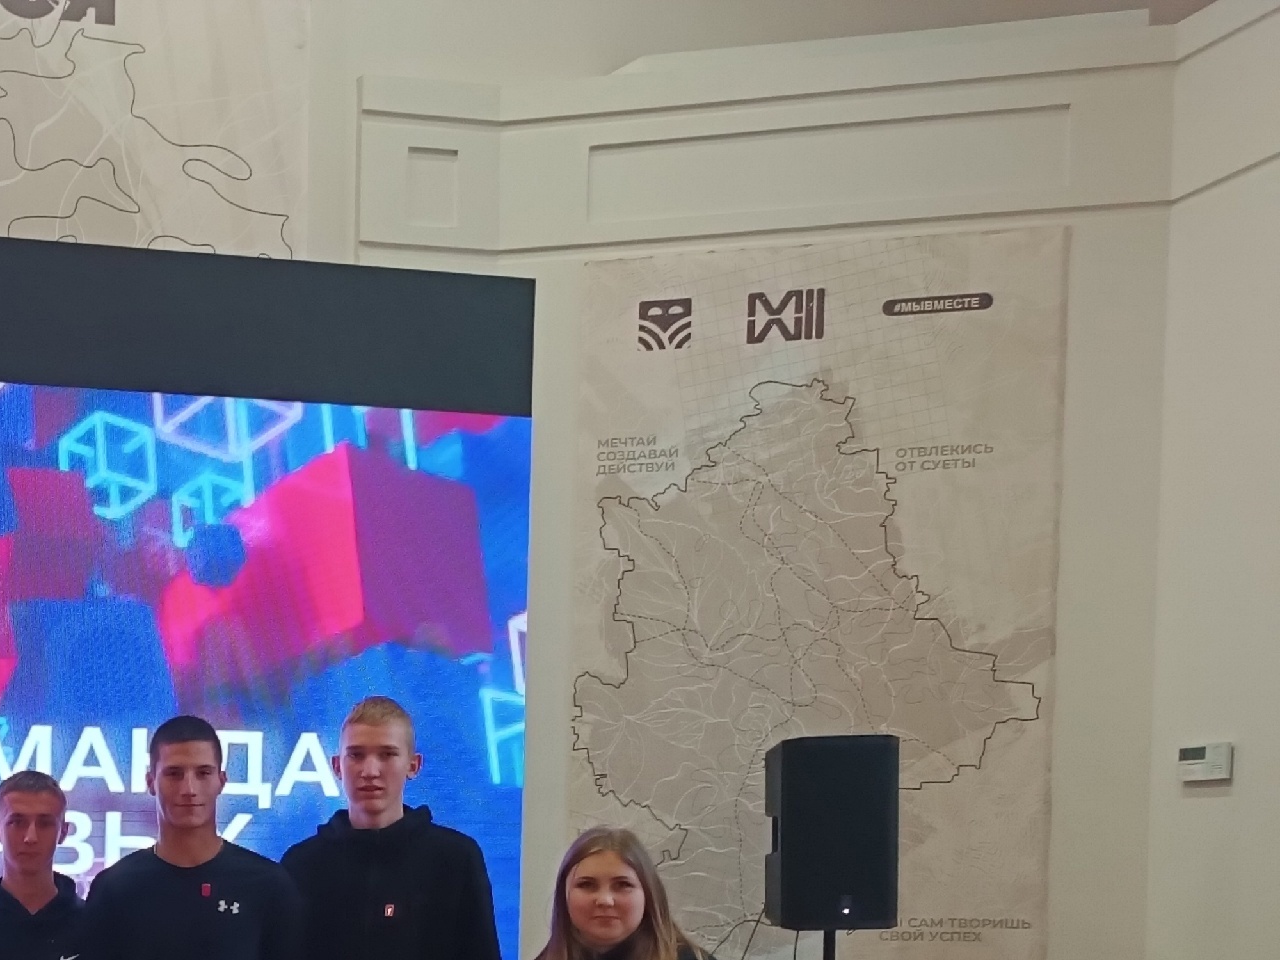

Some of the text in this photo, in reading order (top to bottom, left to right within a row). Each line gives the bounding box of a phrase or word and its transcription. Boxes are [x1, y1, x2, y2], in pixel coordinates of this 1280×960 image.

[893, 297, 980, 313] #МЫВМЕСТЕ
[597, 434, 657, 449] МЕЧТАЙ
[596, 446, 679, 462] СОЗДАВАЙ
[895, 444, 994, 458] ОТВЛЕКИСЬ
[595, 459, 675, 476] ДЕЙСТВУЙ
[895, 457, 976, 472] ОТ СУЕТЫ
[908, 918, 943, 928] САМ
[947, 918, 1032, 930] ТВОРИШЬ
[879, 929, 983, 942] СВОЙ УСПЕХ
